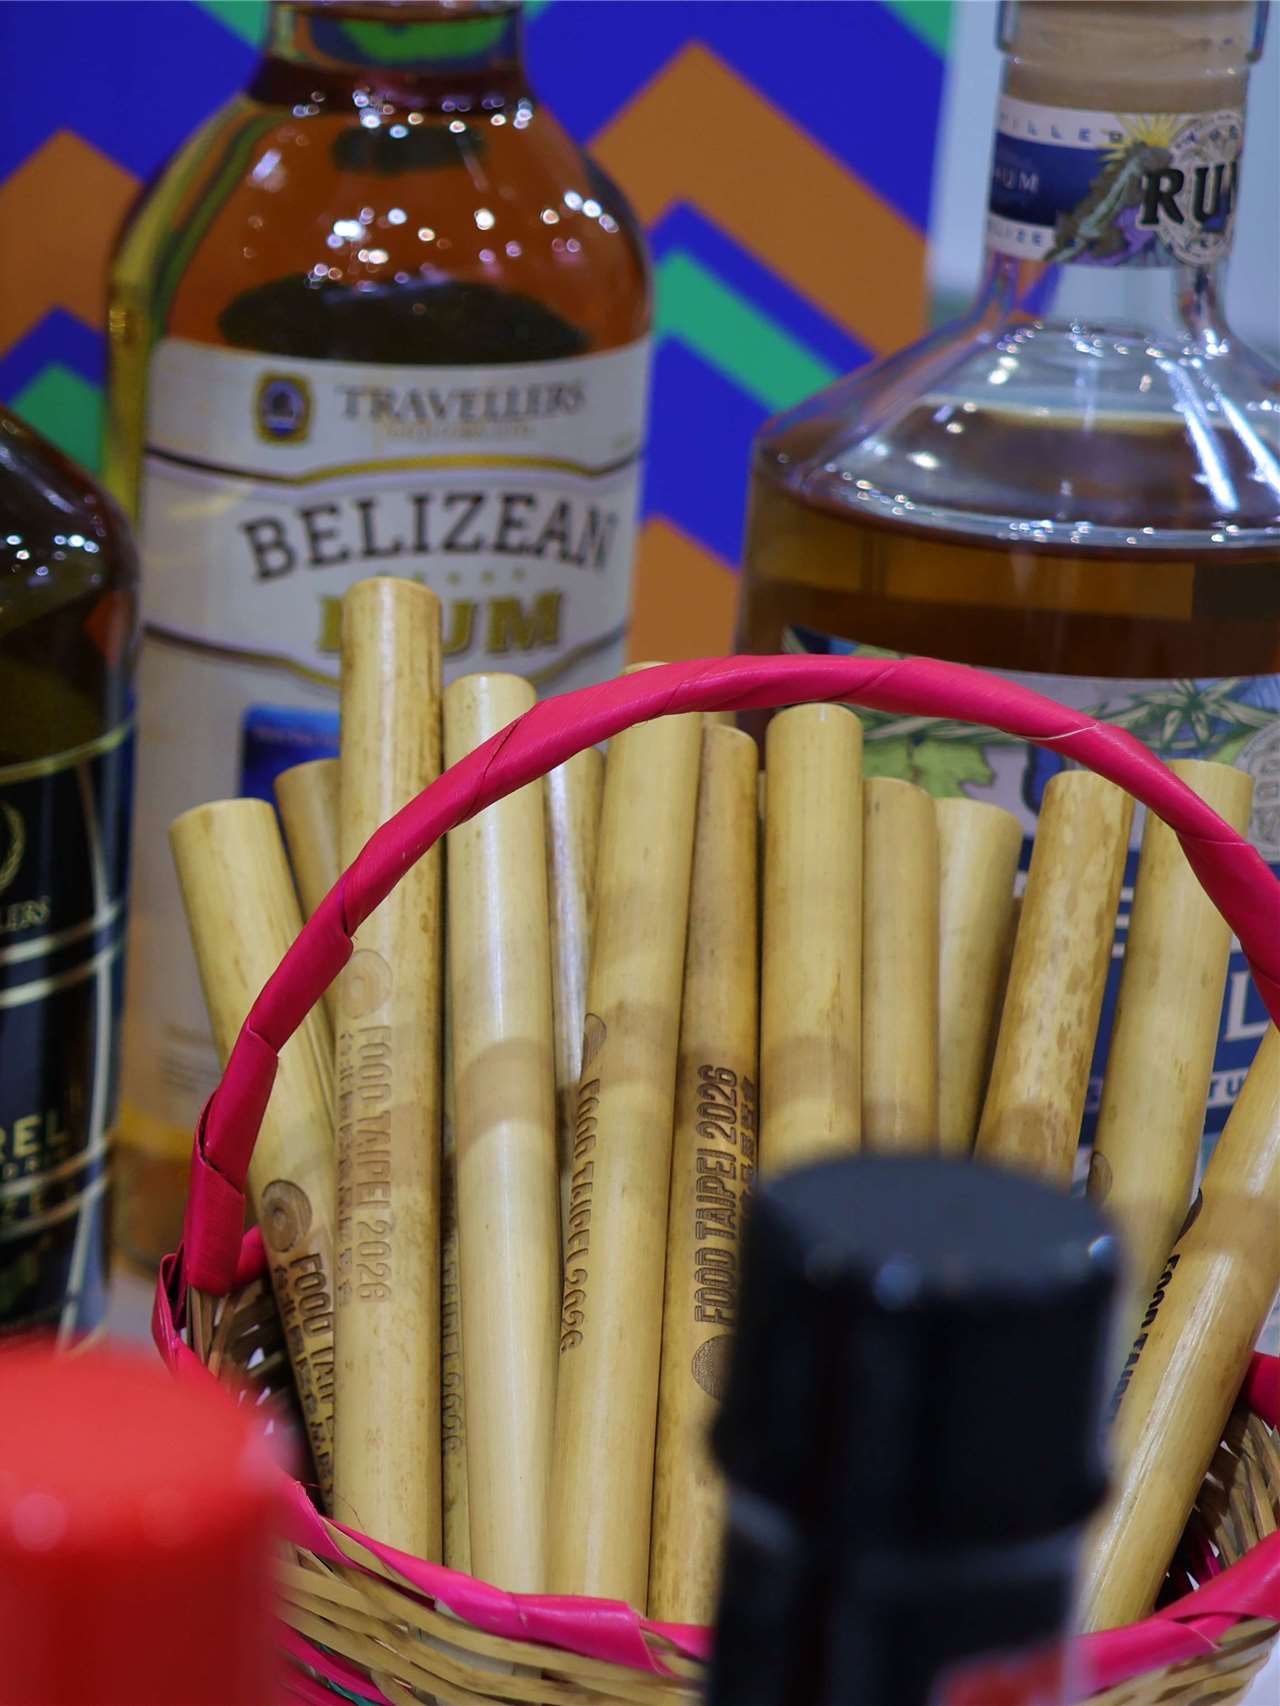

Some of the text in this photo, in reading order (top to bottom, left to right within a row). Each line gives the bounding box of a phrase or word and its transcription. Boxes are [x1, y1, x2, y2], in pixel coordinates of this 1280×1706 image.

[239, 490, 618, 582] BELIZEAN
[357, 1025, 393, 1305] FOOD TAIPEI 2026
[693, 1063, 739, 1328] FOOD TAIPEI 2026
[289, 1252, 335, 1338] FOOD
